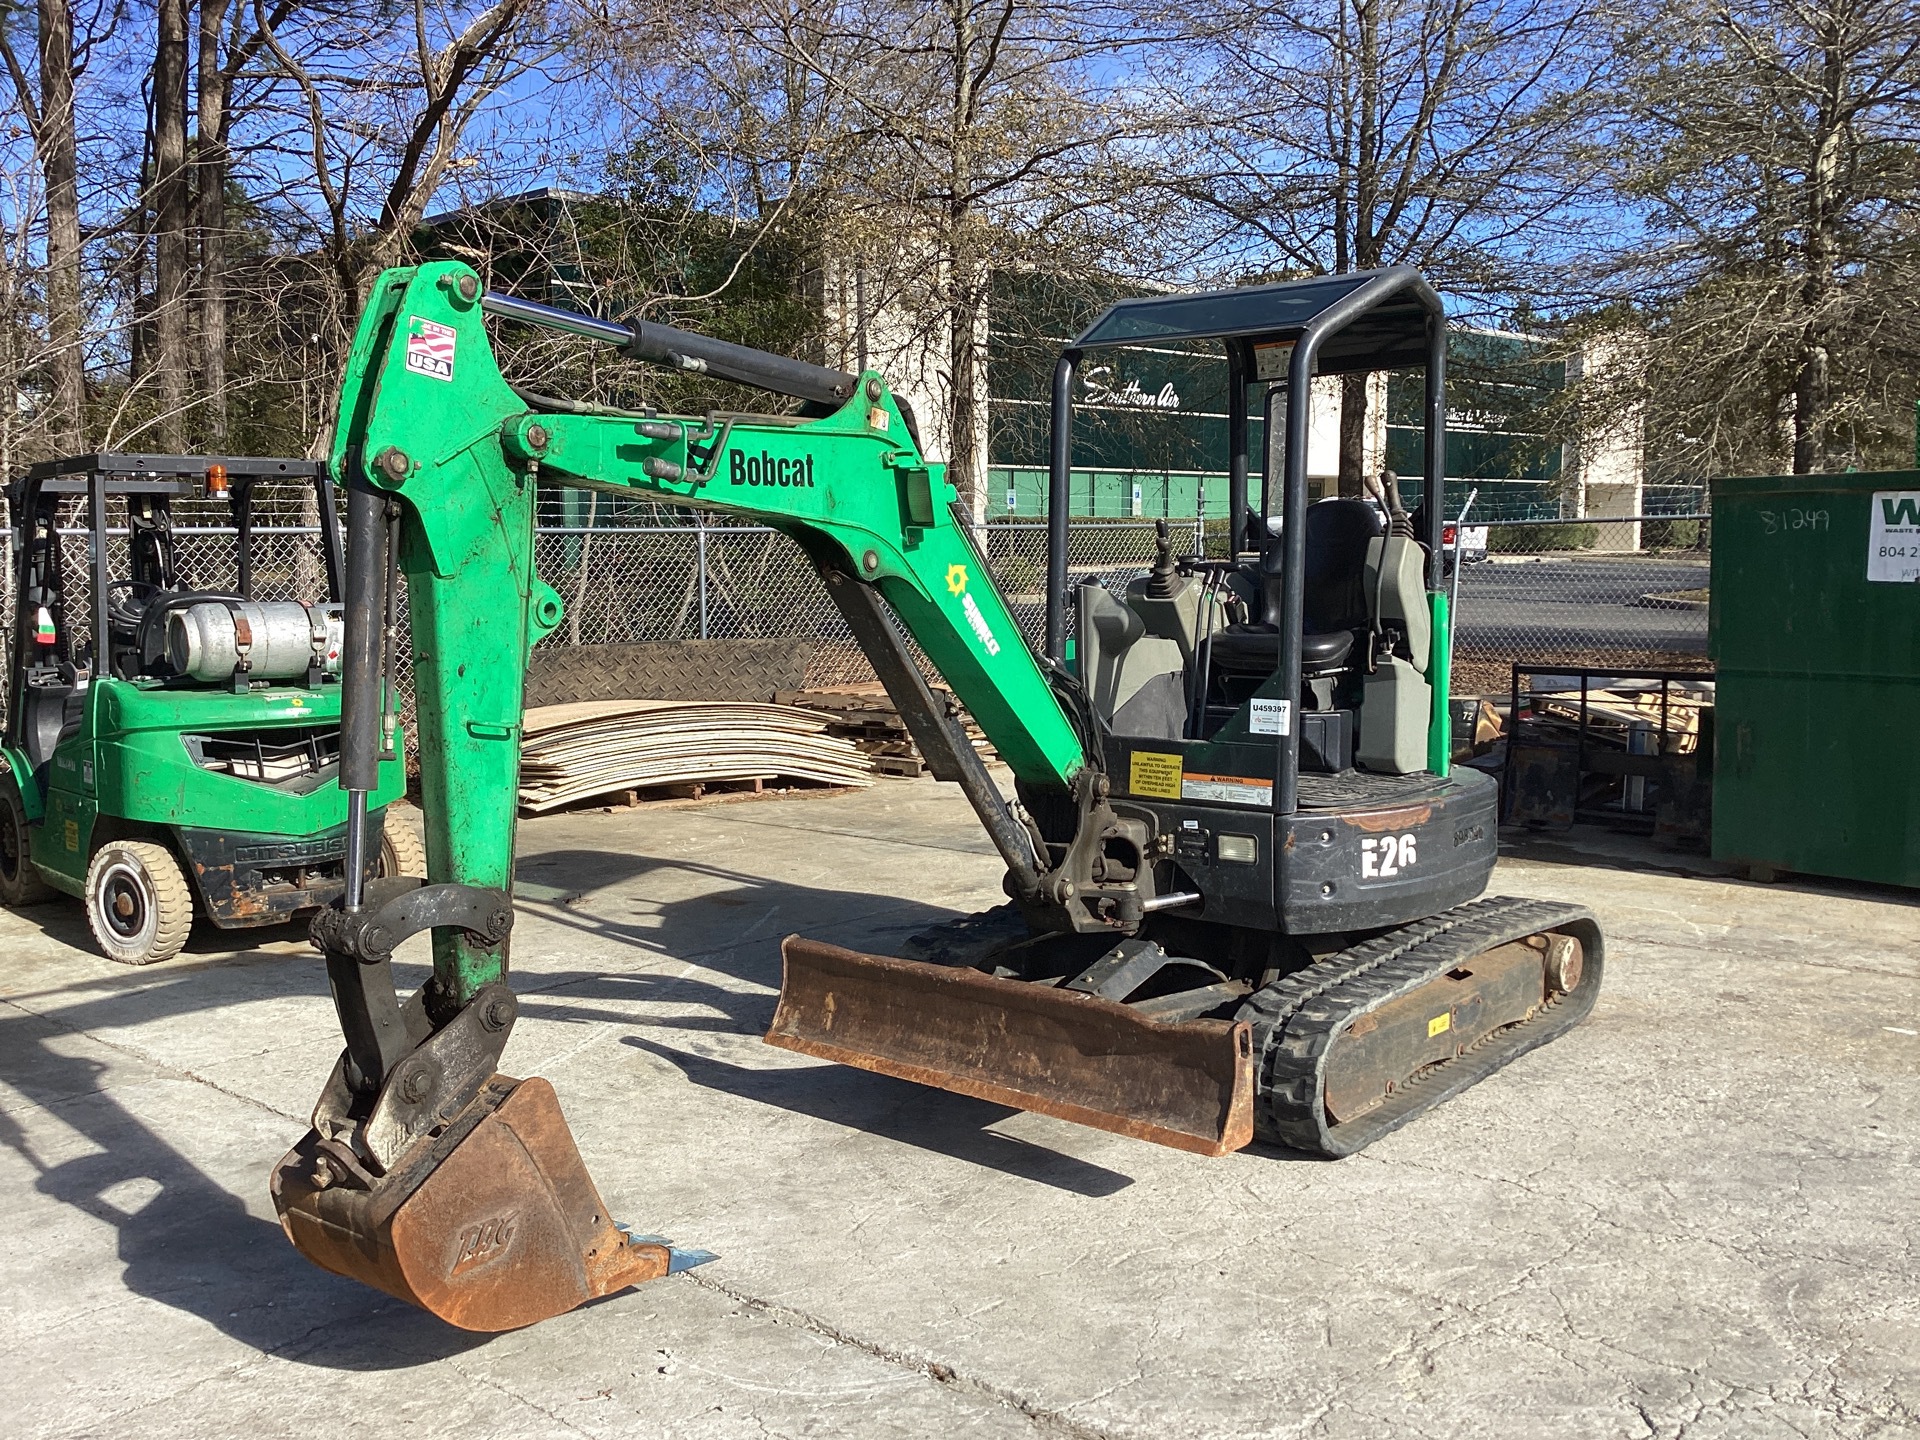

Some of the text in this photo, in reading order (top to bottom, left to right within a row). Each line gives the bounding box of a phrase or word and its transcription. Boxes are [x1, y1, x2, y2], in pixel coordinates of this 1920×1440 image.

[409, 352, 450, 376] USA
[1083, 366, 1180, 408] Southern Air
[729, 448, 815, 488] Bobcat
[1881, 499, 1920, 525] W
[1879, 546, 1920, 558] 804 2
[1252, 704, 1287, 713] U459397
[1462, 711, 1474, 721] 72
[1216, 776, 1244, 784] WARNING
[235, 837, 347, 862] MITSUBIS
[1361, 833, 1417, 879] E26
